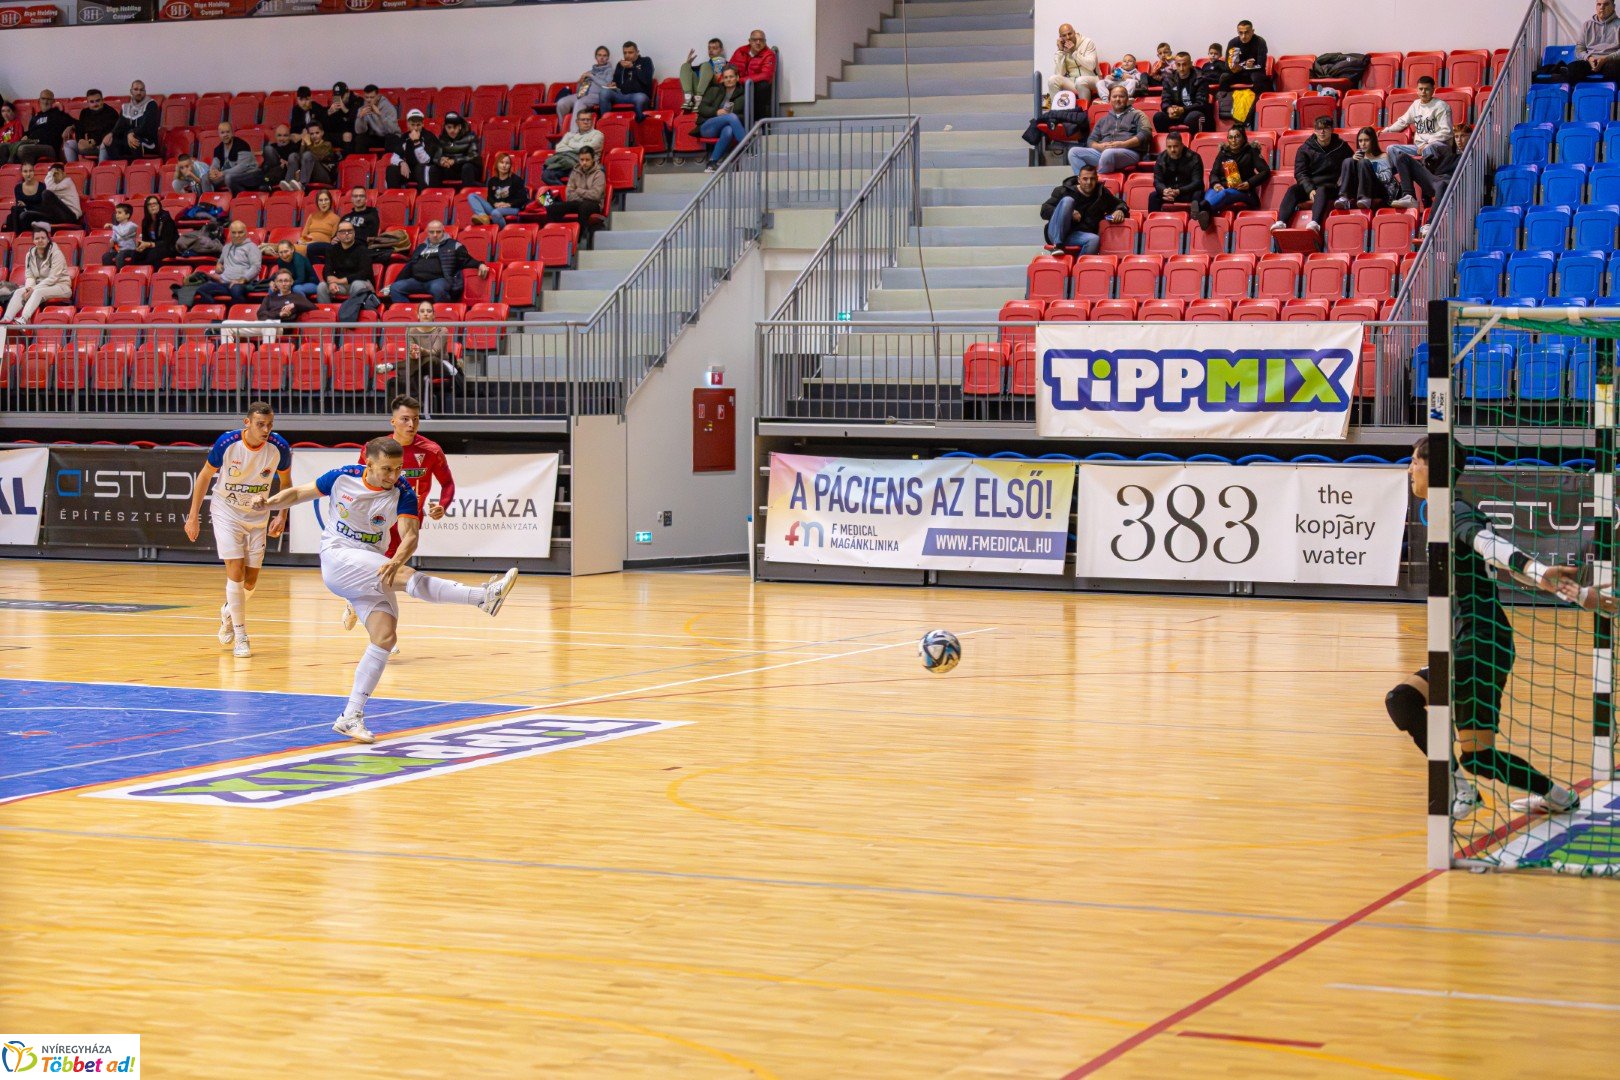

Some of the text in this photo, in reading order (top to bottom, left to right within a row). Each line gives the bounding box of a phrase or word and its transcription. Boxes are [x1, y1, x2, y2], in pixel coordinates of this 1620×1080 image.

[789, 466, 1053, 519] A PÁCIENS AZ ELSŐ!
[1318, 484, 1353, 505] the
[832, 523, 878, 537] F MEDICAL
[1110, 484, 1260, 564] 383
[830, 536, 899, 552] MAGÁNKLINIKA
[936, 534, 1052, 554] WWW.FMEDICAL.HU
[1302, 547, 1367, 565] water
